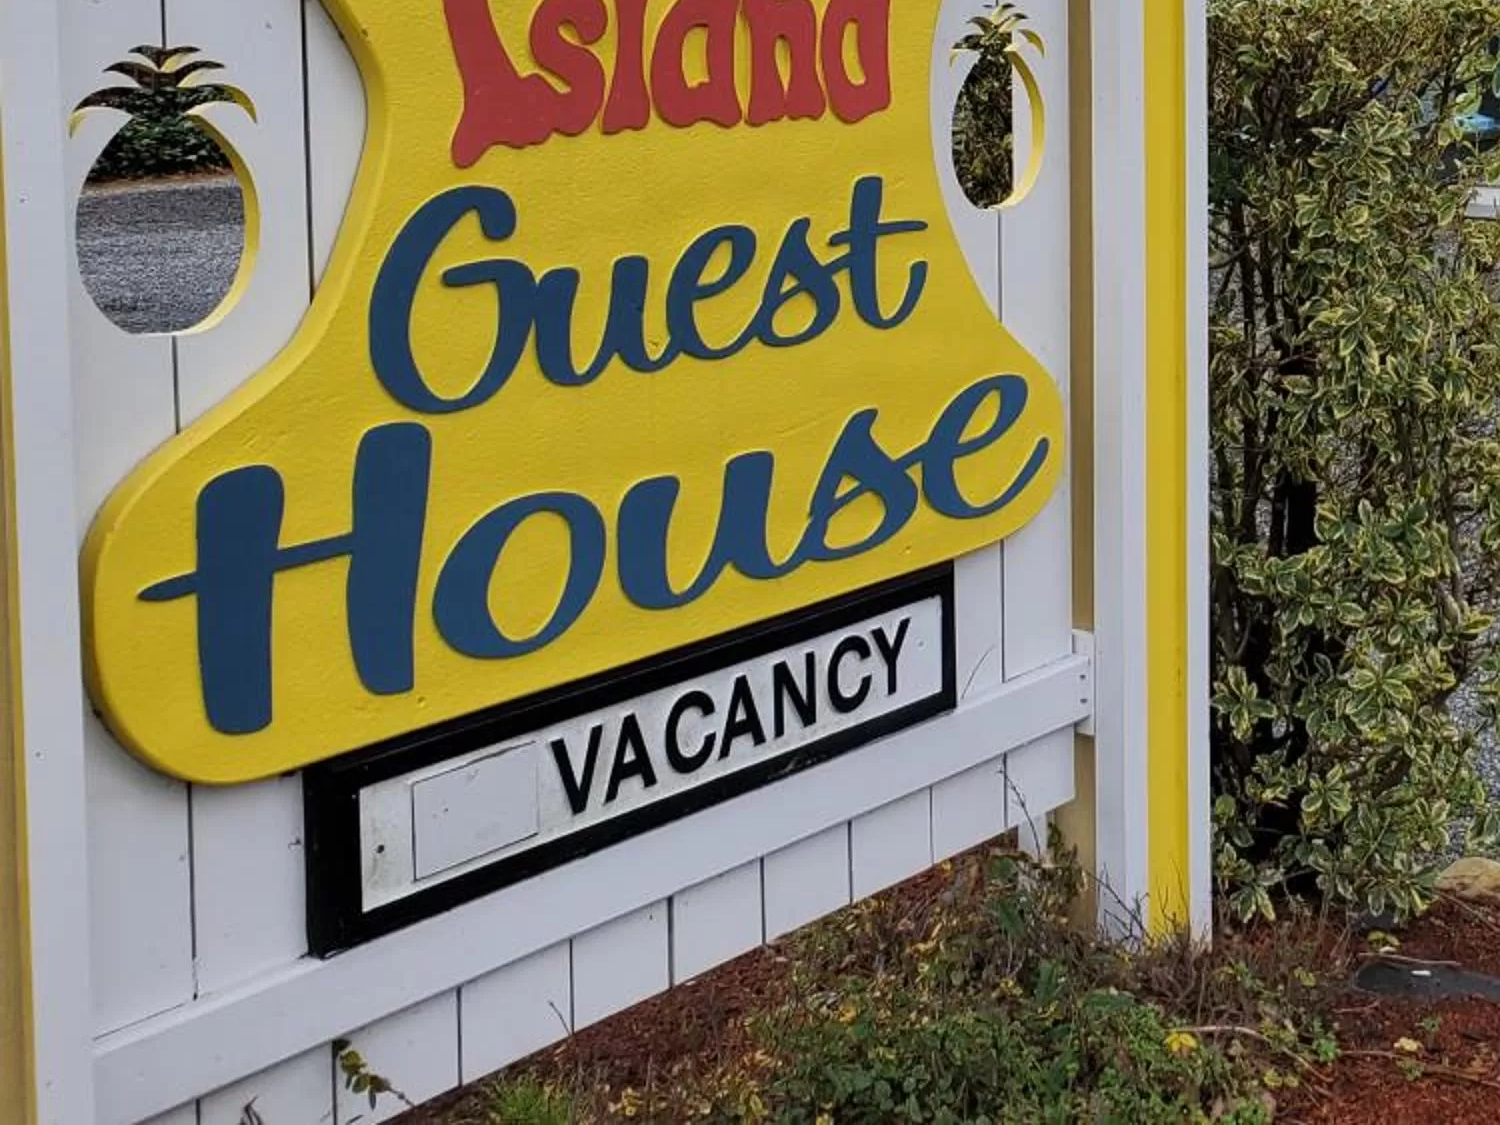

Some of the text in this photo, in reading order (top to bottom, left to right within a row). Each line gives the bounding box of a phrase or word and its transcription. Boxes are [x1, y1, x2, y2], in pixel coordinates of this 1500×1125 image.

[368, 176, 927, 414] Guest
[138, 374, 1050, 735] House
[551, 618, 911, 815] VACANCY
